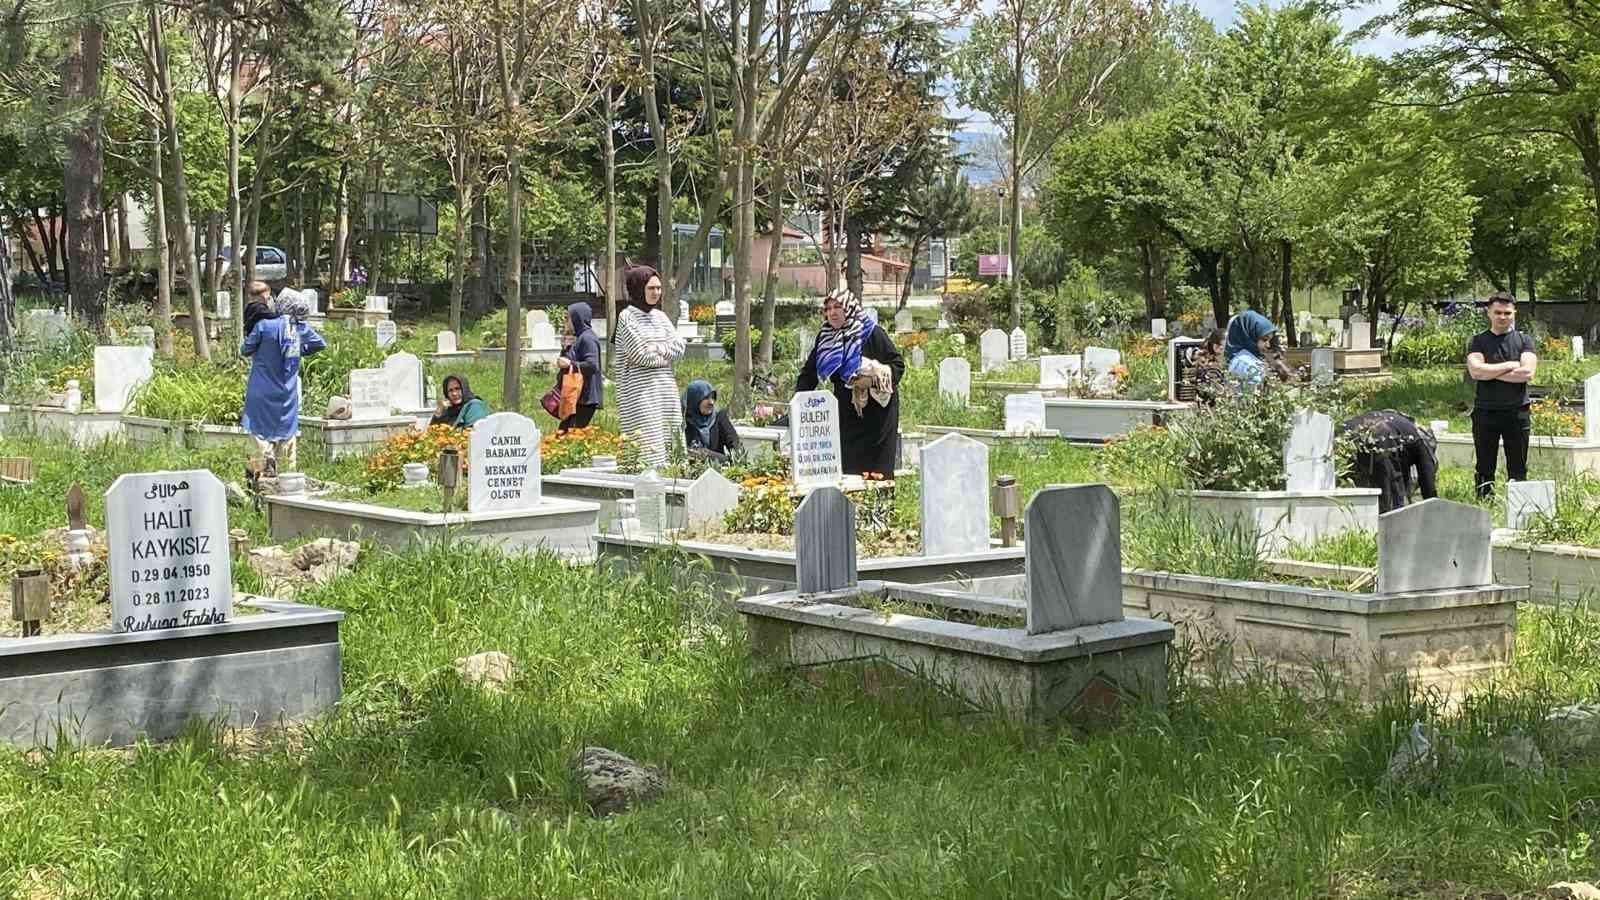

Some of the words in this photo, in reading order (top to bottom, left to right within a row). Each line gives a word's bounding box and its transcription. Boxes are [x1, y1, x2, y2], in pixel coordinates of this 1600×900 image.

[491, 435, 521, 446] CANIM
[485, 447, 527, 458] BABAMIZ
[484, 464, 528, 475] MEKANIN
[487, 476, 524, 487] CENNET
[490, 489, 521, 500] OLSUN
[144, 504, 193, 530] HALİT
[131, 535, 211, 560] KAYKISIZ
[123, 613, 179, 632] Ruhuna
[183, 607, 226, 626] Fatiha
